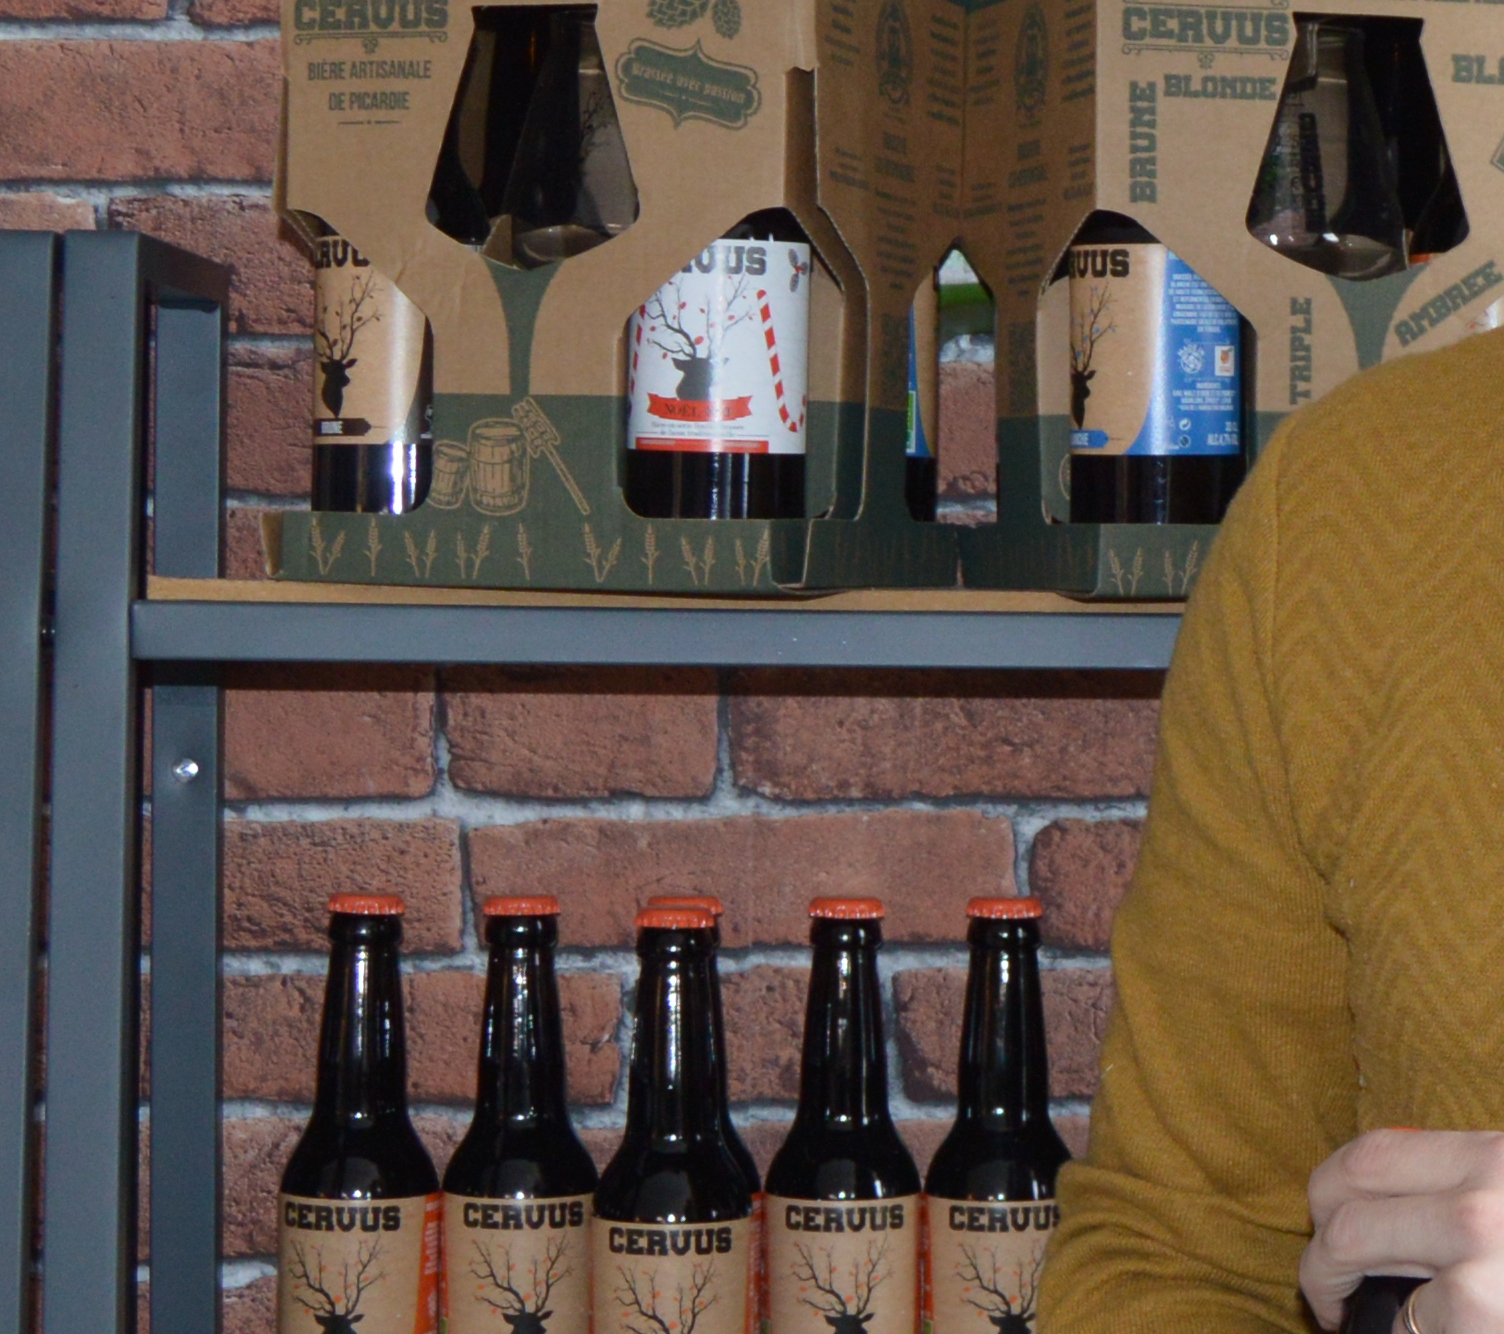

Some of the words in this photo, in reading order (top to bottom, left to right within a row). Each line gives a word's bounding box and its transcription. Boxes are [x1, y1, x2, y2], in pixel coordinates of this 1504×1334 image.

[1122, 5, 1289, 48] CERVUS
[349, 58, 433, 80] ARTISANALE
[328, 91, 346, 111] DE
[349, 89, 411, 111] PICARDIE
[1163, 73, 1278, 101] BLONDE
[1128, 80, 1158, 205] BRUNE
[1288, 295, 1313, 405] TRIPLE
[284, 1201, 402, 1233] CERVUS
[462, 1201, 584, 1231] CERVUS
[784, 1203, 905, 1233] CERVUS
[608, 1225, 733, 1257] CERVUS
